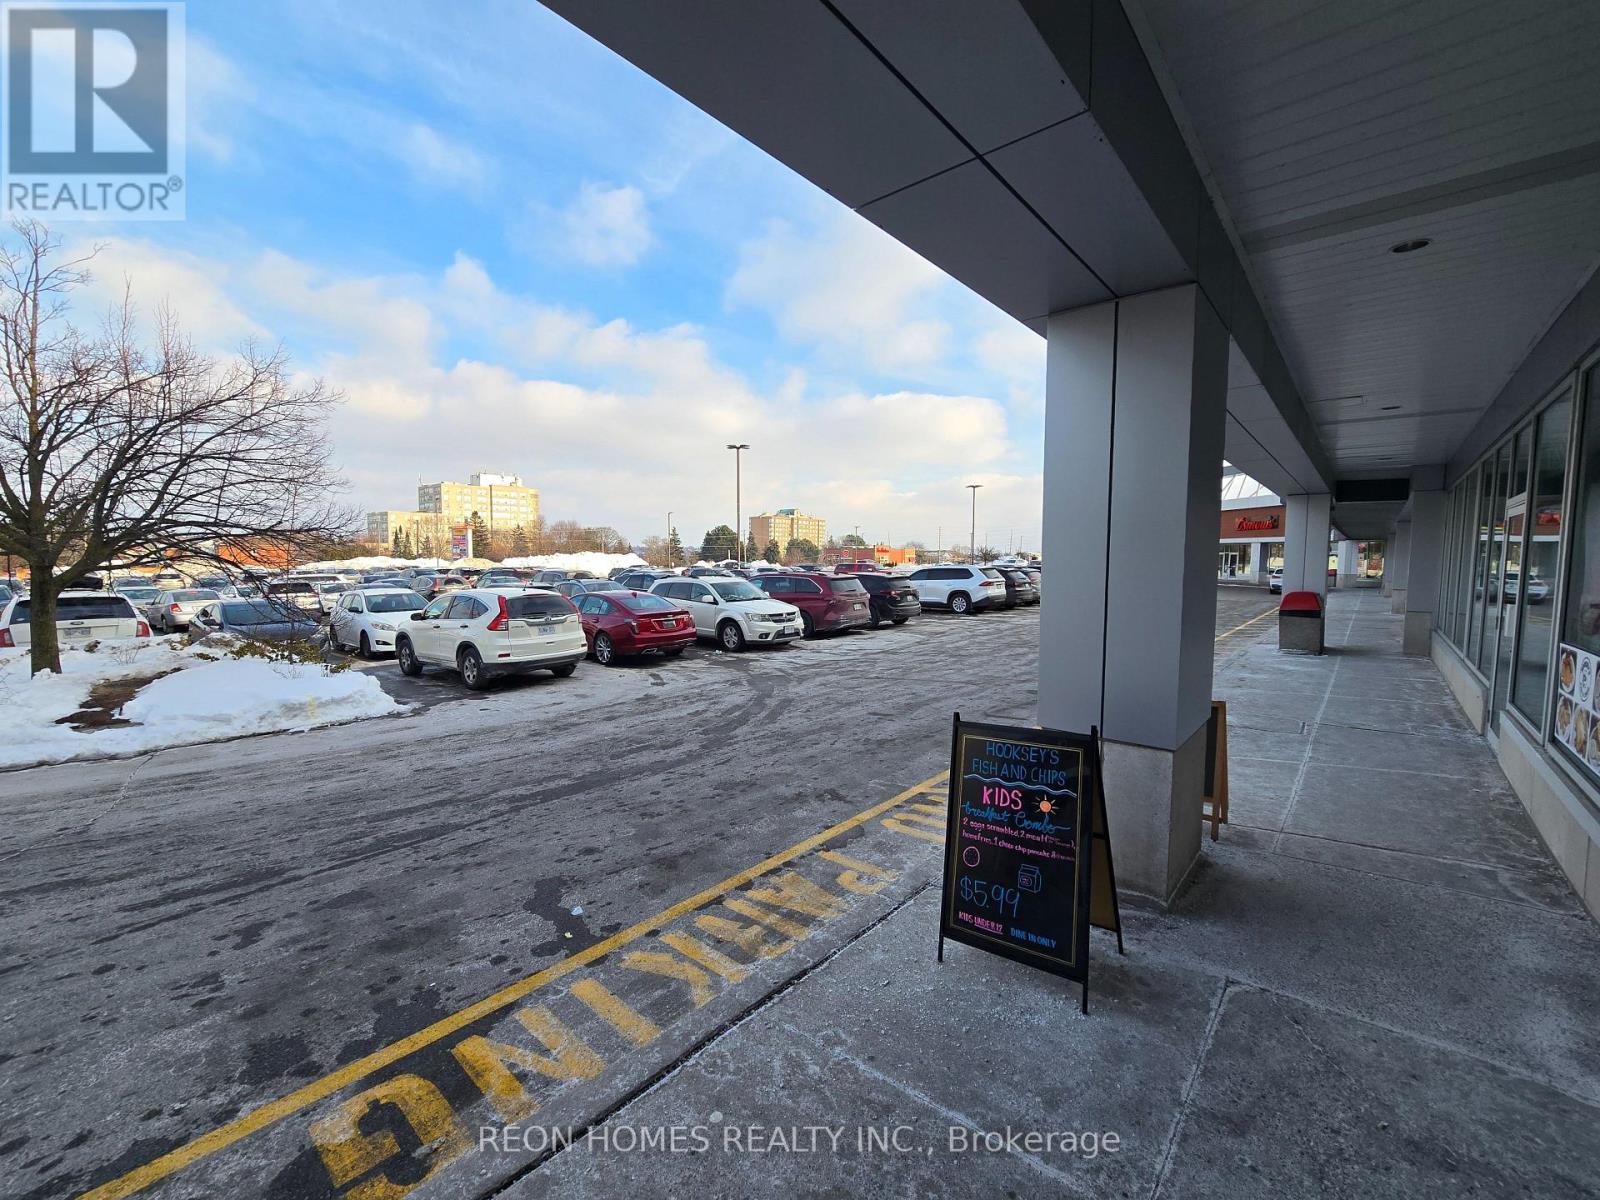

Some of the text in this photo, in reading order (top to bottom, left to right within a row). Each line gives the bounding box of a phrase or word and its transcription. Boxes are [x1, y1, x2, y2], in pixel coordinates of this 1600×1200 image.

[986, 741, 1060, 765] HOOKSEY'S
[972, 758, 1066, 786] FISH AND CHIPS
[982, 786, 1022, 810] KIDS
[963, 817, 969, 826] 2
[1020, 830, 1026, 838] 2
[960, 875, 1020, 919] $5.99
[958, 911, 974, 923] KIDS
[974, 916, 995, 930] UNDER
[1010, 927, 1056, 948] DINE IN ONLY
[308, 848, 899, 1200] PARKING
